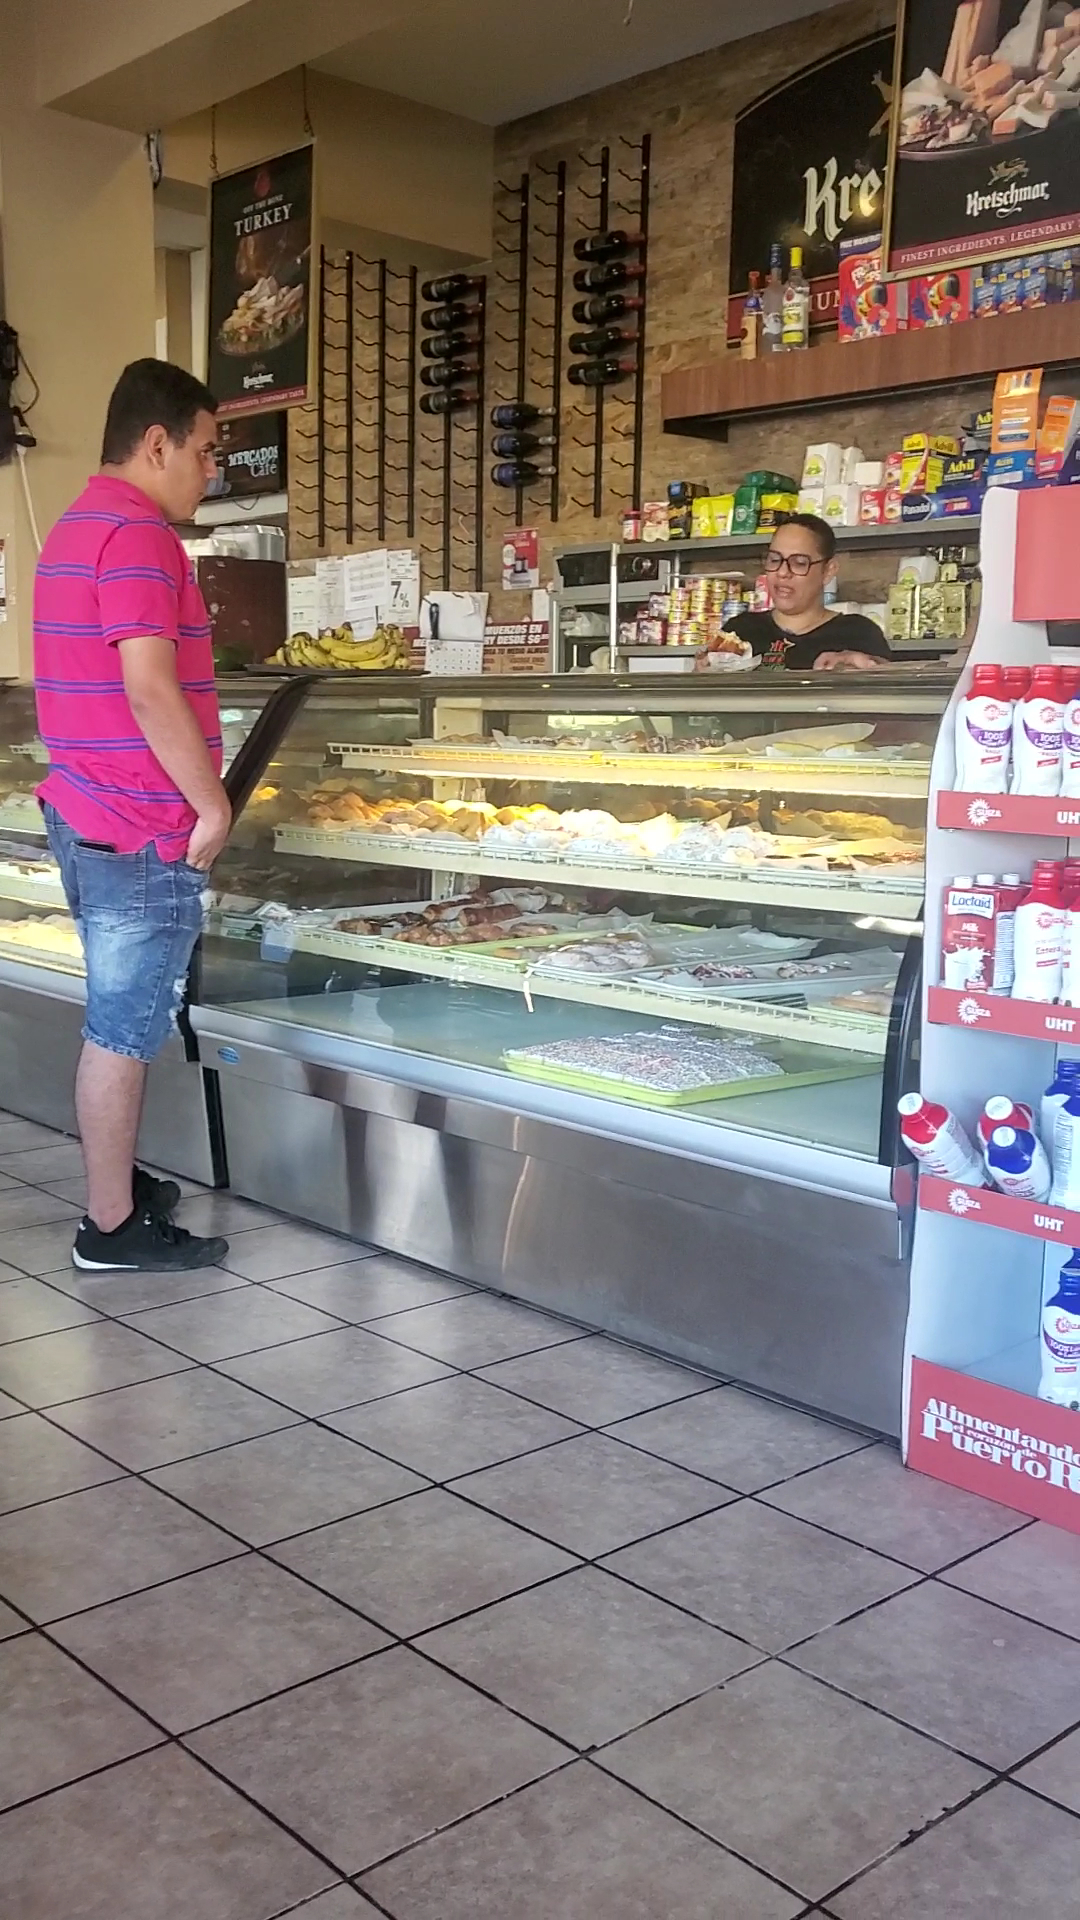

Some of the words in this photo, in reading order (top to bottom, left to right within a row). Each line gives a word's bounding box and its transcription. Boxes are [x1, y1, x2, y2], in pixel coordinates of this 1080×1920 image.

[802, 156, 888, 242] Kre
[966, 181, 1050, 218] Kretschmar
[233, 203, 293, 236] TURKEY
[900, 250, 935, 264] FINEST
[1010, 220, 1075, 242] LEGENDARY
[227, 445, 278, 467] MERCADOS
[949, 458, 976, 474] Advil
[902, 503, 931, 516] Panadol
[529, 623, 542, 634] EN
[497, 634, 527, 645] DESDE
[975, 807, 1002, 818] SUIZA
[1056, 811, 1080, 825] UH
[951, 894, 992, 909] Lactaid
[961, 922, 980, 932] Milk
[965, 1005, 992, 1018] SUIZA
[1044, 1017, 1077, 1033] UHT
[956, 1196, 982, 1210] SUIZA
[1033, 1214, 1065, 1232] UHT
[920, 1409, 1048, 1480] Puerto
[952, 1423, 965, 1434] el
[967, 1429, 1016, 1452] corazón
[1022, 1448, 1038, 1459] de
